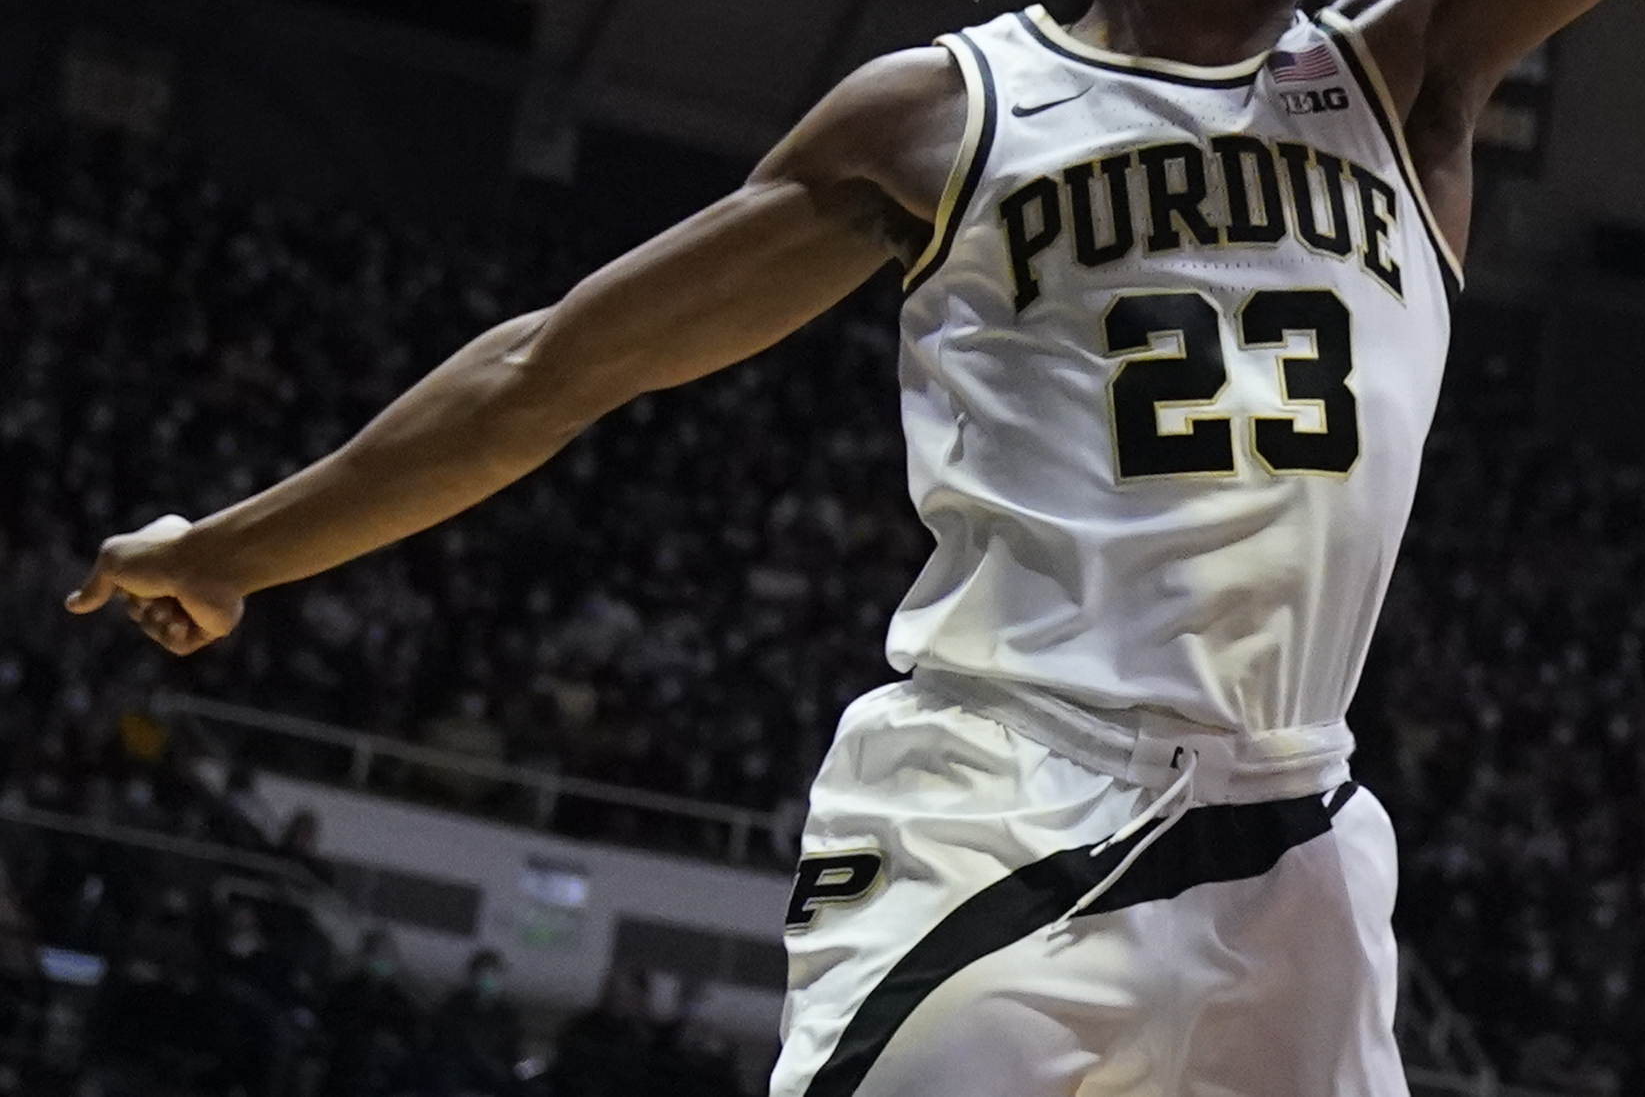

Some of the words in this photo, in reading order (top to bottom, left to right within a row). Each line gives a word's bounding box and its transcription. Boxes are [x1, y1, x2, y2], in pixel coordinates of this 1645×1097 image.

[997, 133, 1406, 315] PURDUE
[1101, 287, 1361, 484] 23
[784, 848, 886, 936] P
